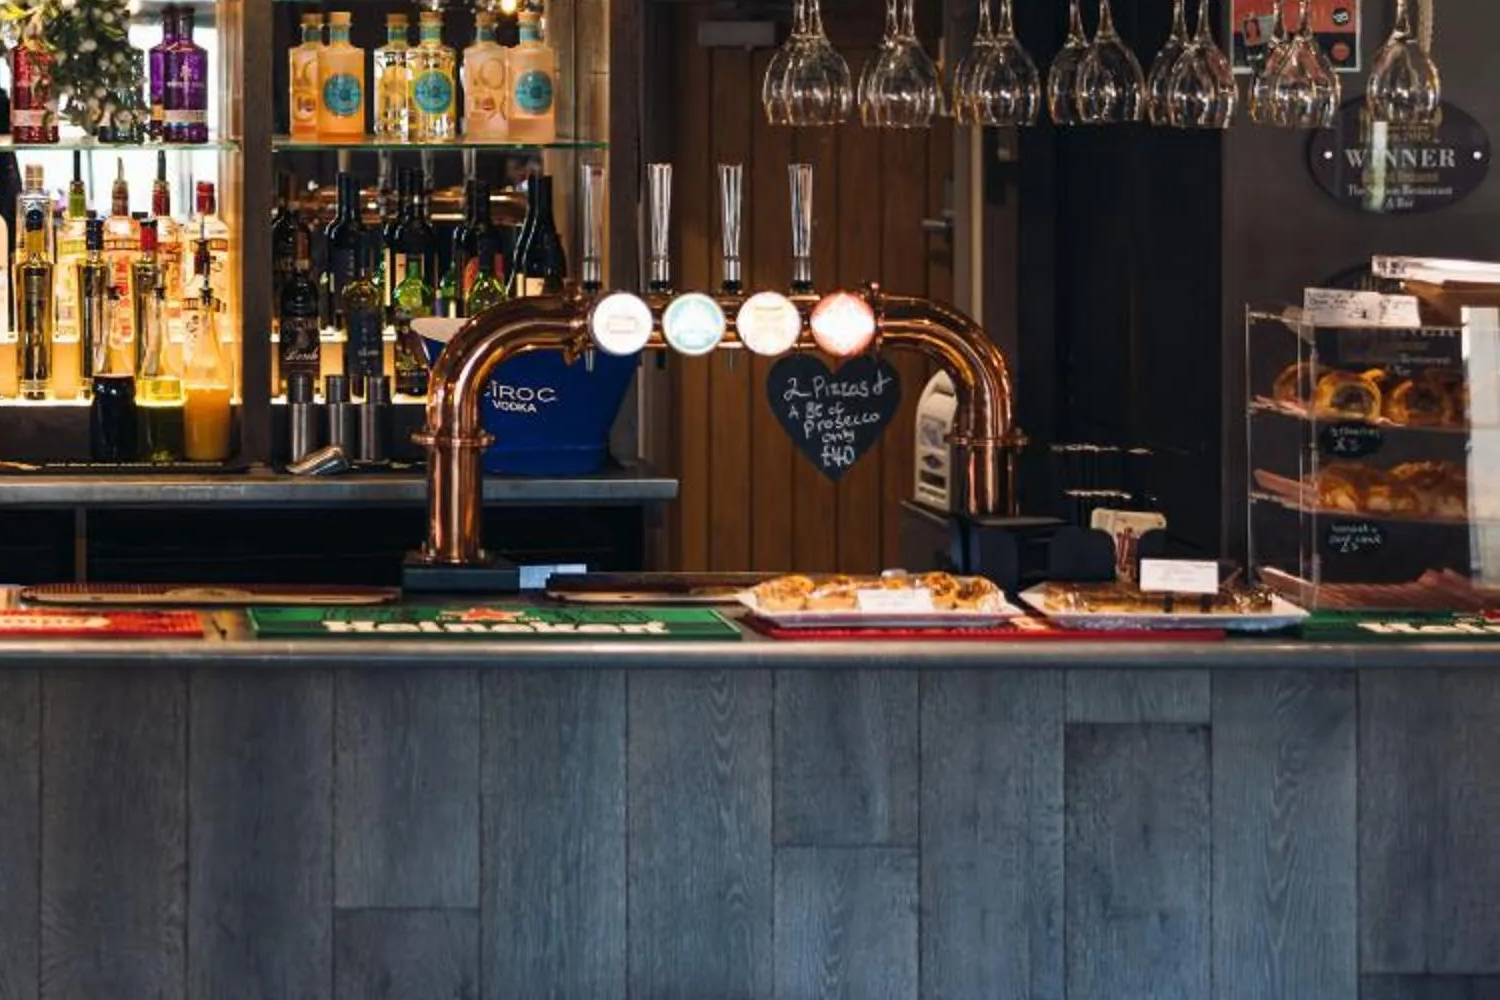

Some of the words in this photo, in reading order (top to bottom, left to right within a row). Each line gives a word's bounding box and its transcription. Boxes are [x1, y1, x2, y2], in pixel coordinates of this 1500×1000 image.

[1345, 148, 1456, 168] WNNER
[484, 379, 558, 402] ÎROC
[492, 400, 537, 413] VODKA
[321, 619, 669, 634] Heineken
